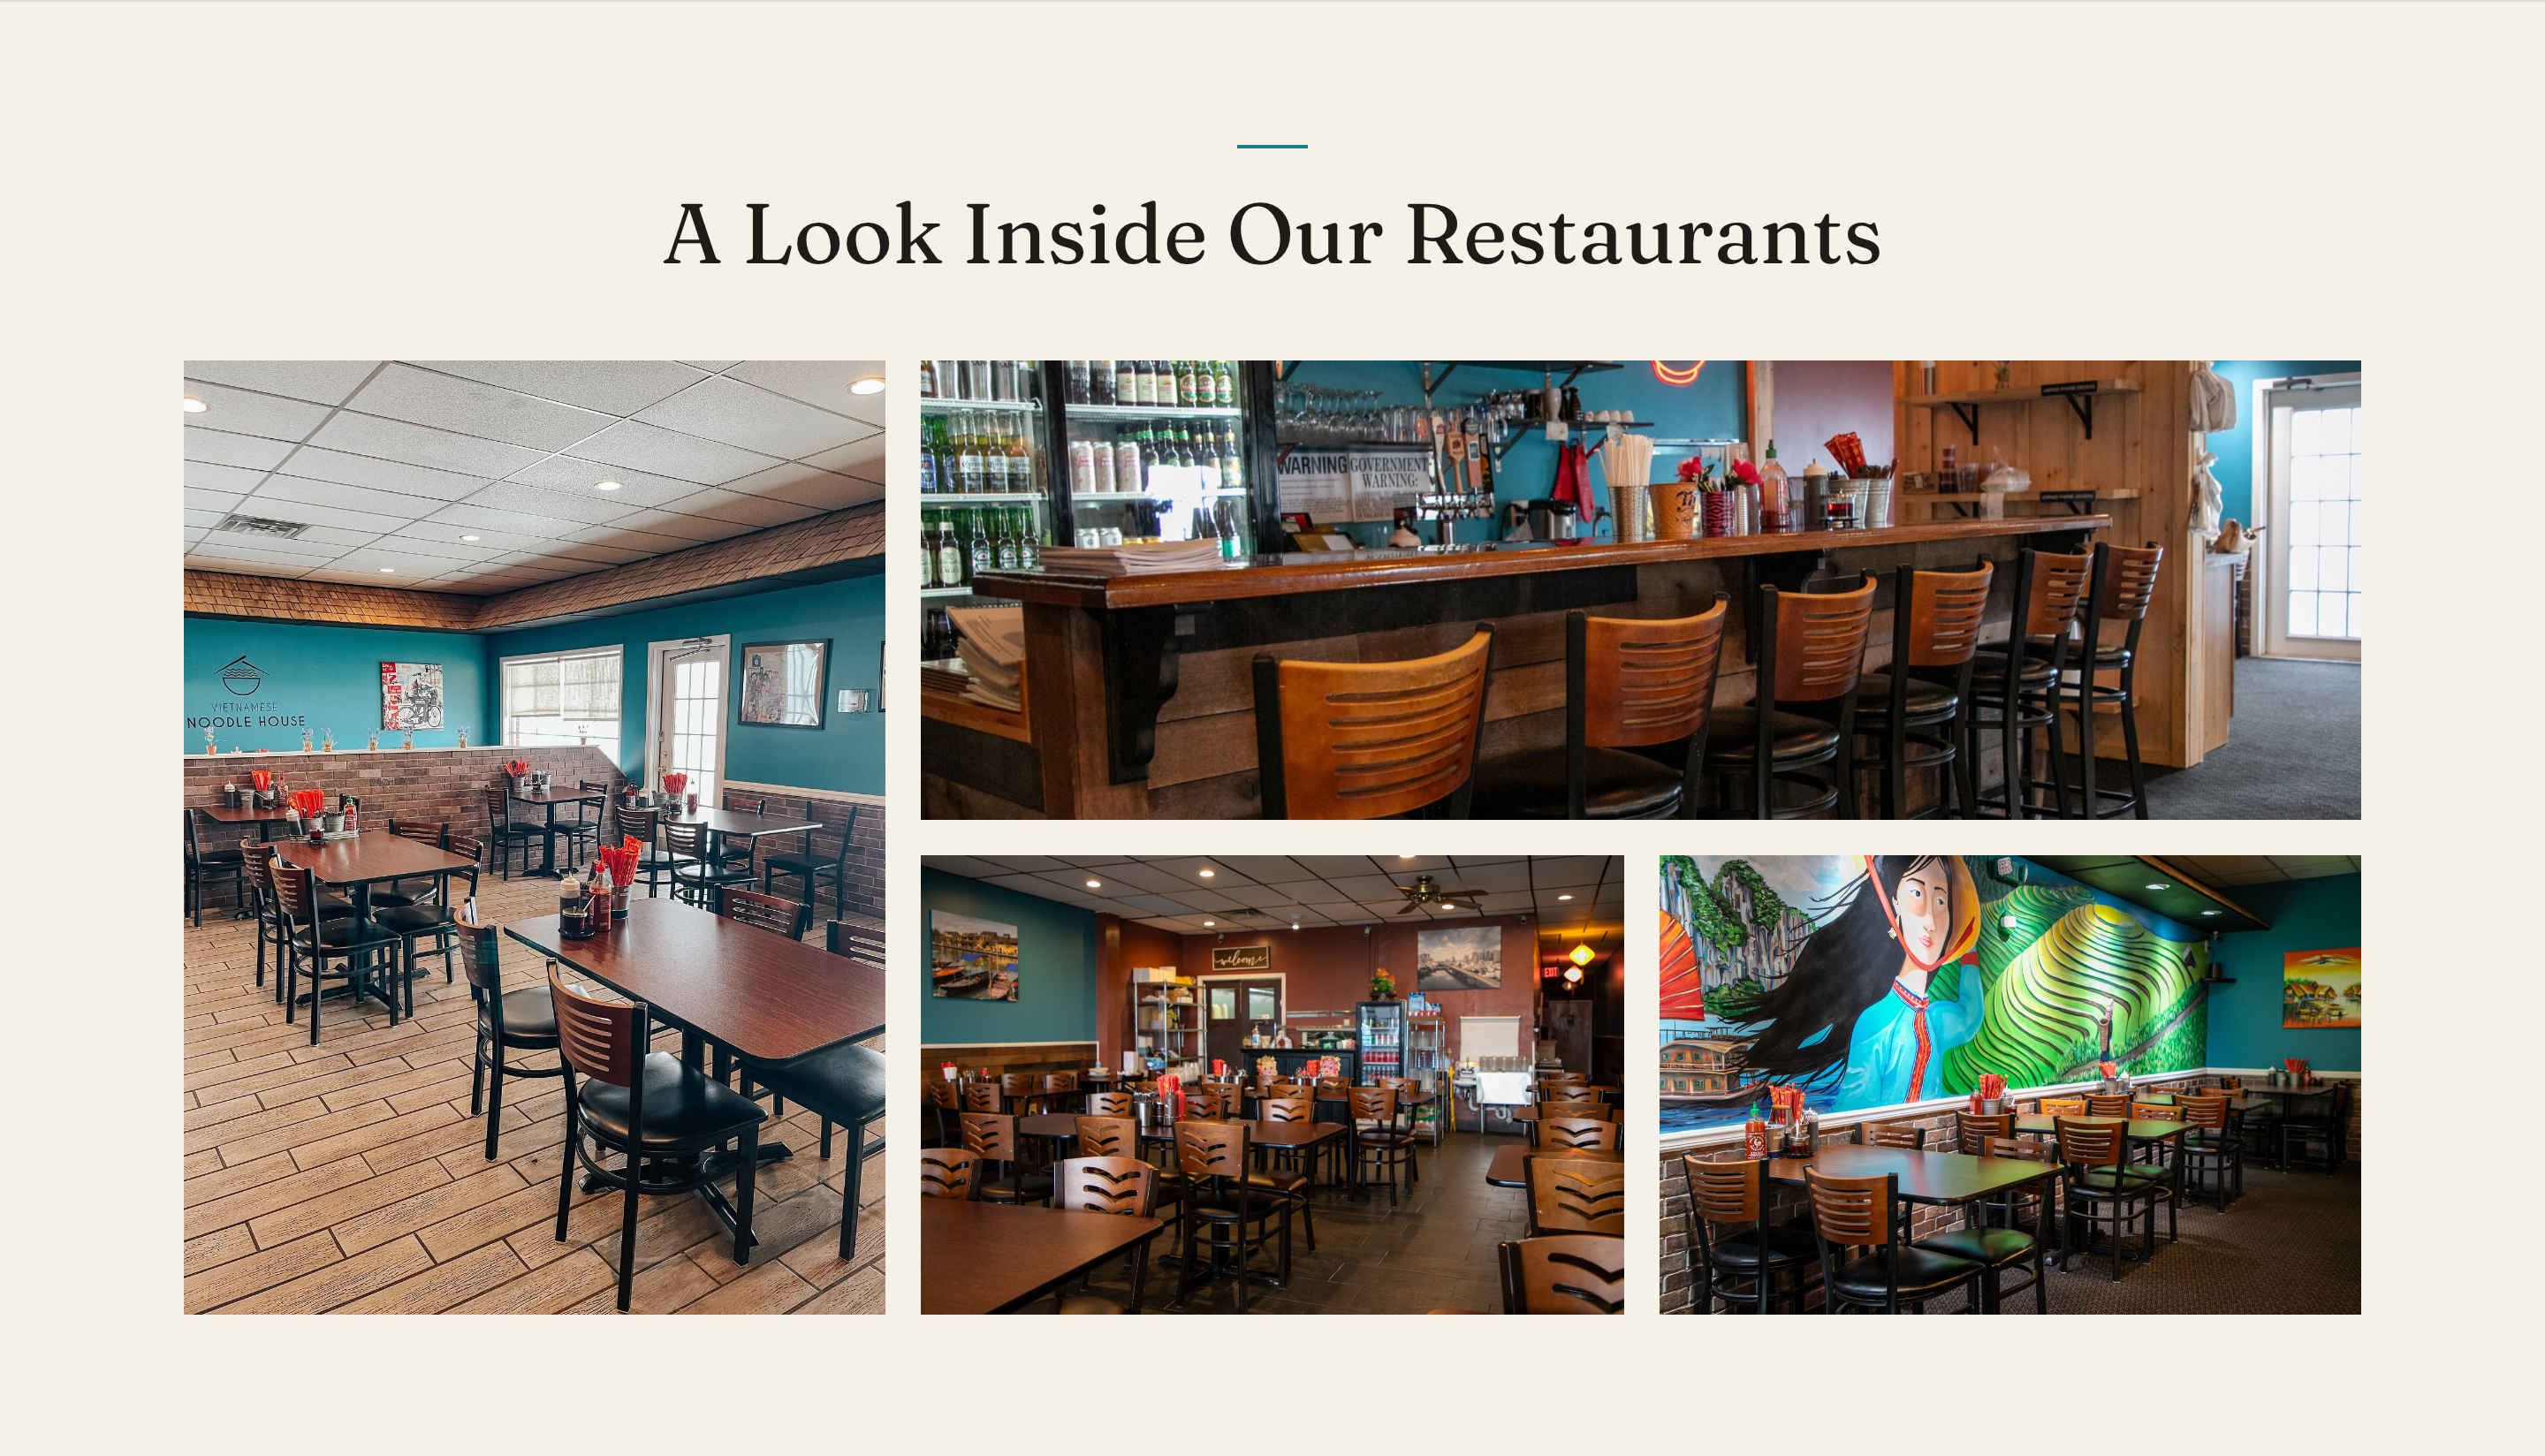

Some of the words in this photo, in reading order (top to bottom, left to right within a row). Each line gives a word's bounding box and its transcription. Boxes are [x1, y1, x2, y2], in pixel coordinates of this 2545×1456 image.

[1279, 456, 1348, 474] WARNING
[1350, 457, 1428, 473] GOVERNMENT
[1362, 473, 1418, 488] WARNING:
[211, 702, 277, 712] VIETNAMESE
[186, 717, 251, 728] NOODLE
[259, 716, 306, 727] HOUSE
[1214, 949, 1266, 967] welcome
[1544, 967, 1558, 978] EXIT
